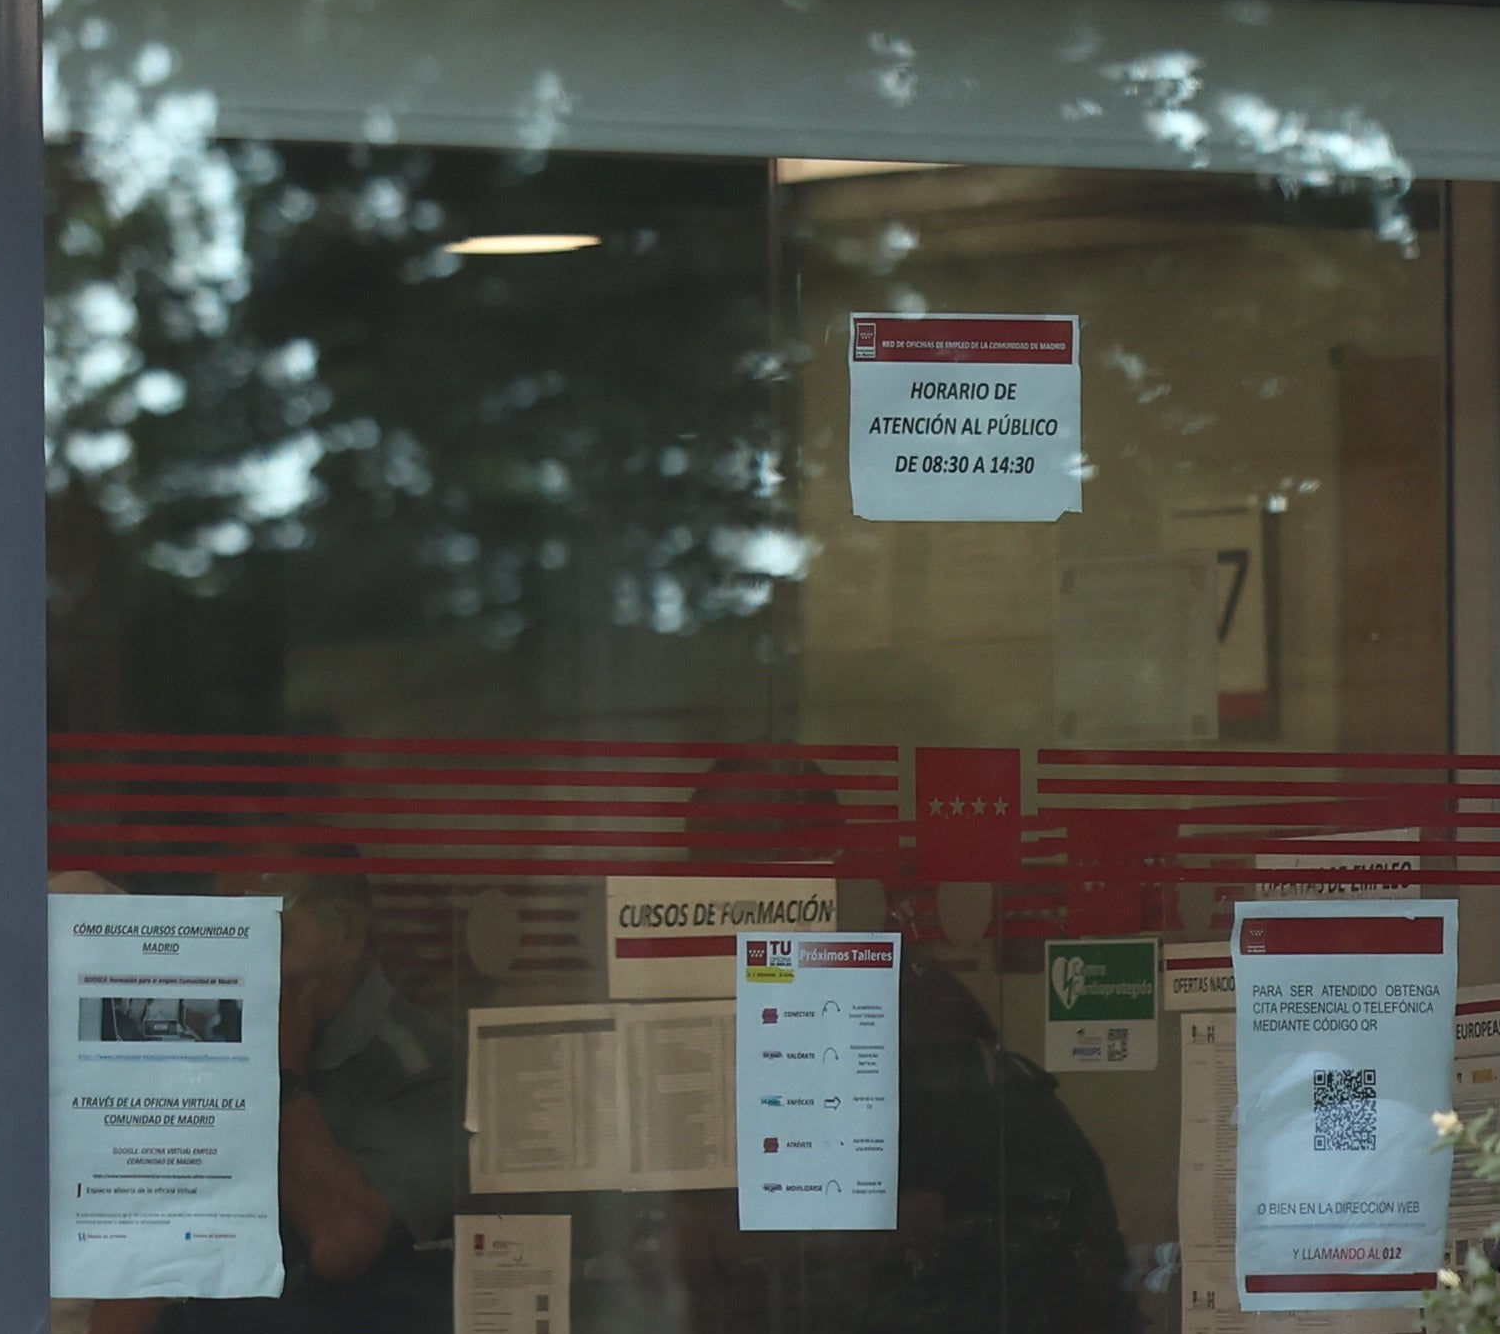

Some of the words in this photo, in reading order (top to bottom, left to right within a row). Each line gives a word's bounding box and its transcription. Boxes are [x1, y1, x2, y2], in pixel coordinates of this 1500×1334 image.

[905, 341, 935, 349] OFICINAS
[936, 341, 944, 349] DE
[989, 342, 1029, 350] COMUNIDAD
[911, 382, 989, 400] HORARIO
[994, 383, 1017, 400] DE
[869, 413, 956, 435] ATENCIÓN
[961, 418, 982, 435] AL
[988, 414, 1058, 436] PÚBLICO
[895, 456, 918, 473] DE
[922, 456, 969, 473] 08:30
[973, 457, 985, 473] A
[990, 456, 1035, 474] 14:30
[620, 904, 688, 927] CURSOS
[694, 904, 714, 926] DE
[721, 894, 834, 925] FORMACIÓN
[73, 923, 102, 935] CÓMO
[105, 925, 139, 935] BUSCAR
[141, 926, 176, 936] CURSOS
[178, 926, 235, 936] COMUNIDAD
[237, 927, 249, 937] DE
[143, 943, 179, 953] MADRID
[770, 941, 791, 955] TU
[800, 950, 849, 961] Próximos
[852, 950, 892, 961] Talleres
[1174, 977, 1207, 994] OFERTAS
[1253, 986, 1282, 996] PARA
[1290, 986, 1313, 996] SER
[1321, 985, 1377, 996] ATENDIDO
[1385, 985, 1440, 996] OBTENGA
[1253, 1003, 1277, 1013] CITA
[1280, 1002, 1349, 1013] PRESENCIAL
[1352, 1002, 1361, 1013] O
[1364, 1000, 1434, 1013] TELEFÓNICA
[1253, 1020, 1309, 1031] MEDIANTE
[1314, 1018, 1358, 1031] CÓDIGO
[1361, 1020, 1377, 1030] QR
[72, 1097, 78, 1107] A
[81, 1096, 115, 1107] TRAVÉS
[117, 1098, 128, 1107] DE
[131, 1098, 141, 1107] LA
[144, 1098, 179, 1107] OFICINA
[182, 1098, 220, 1108] VIRTUAL
[222, 1099, 233, 1108] DE
[235, 1099, 245, 1108] LA
[104, 1115, 161, 1125] COMUNIDAD
[163, 1115, 175, 1125] DE
[178, 1115, 215, 1125] MADRID
[1258, 1204, 1266, 1215] O
[1270, 1204, 1296, 1215] BIEN
[1300, 1203, 1315, 1214] EN
[1319, 1203, 1332, 1214] LA
[1397, 1202, 1419, 1214] WEB
[1293, 1249, 1299, 1259] Y
[1302, 1248, 1364, 1260] LLAMANDO
[1368, 1248, 1380, 1259] AL
[1383, 1248, 1402, 1259] 012
